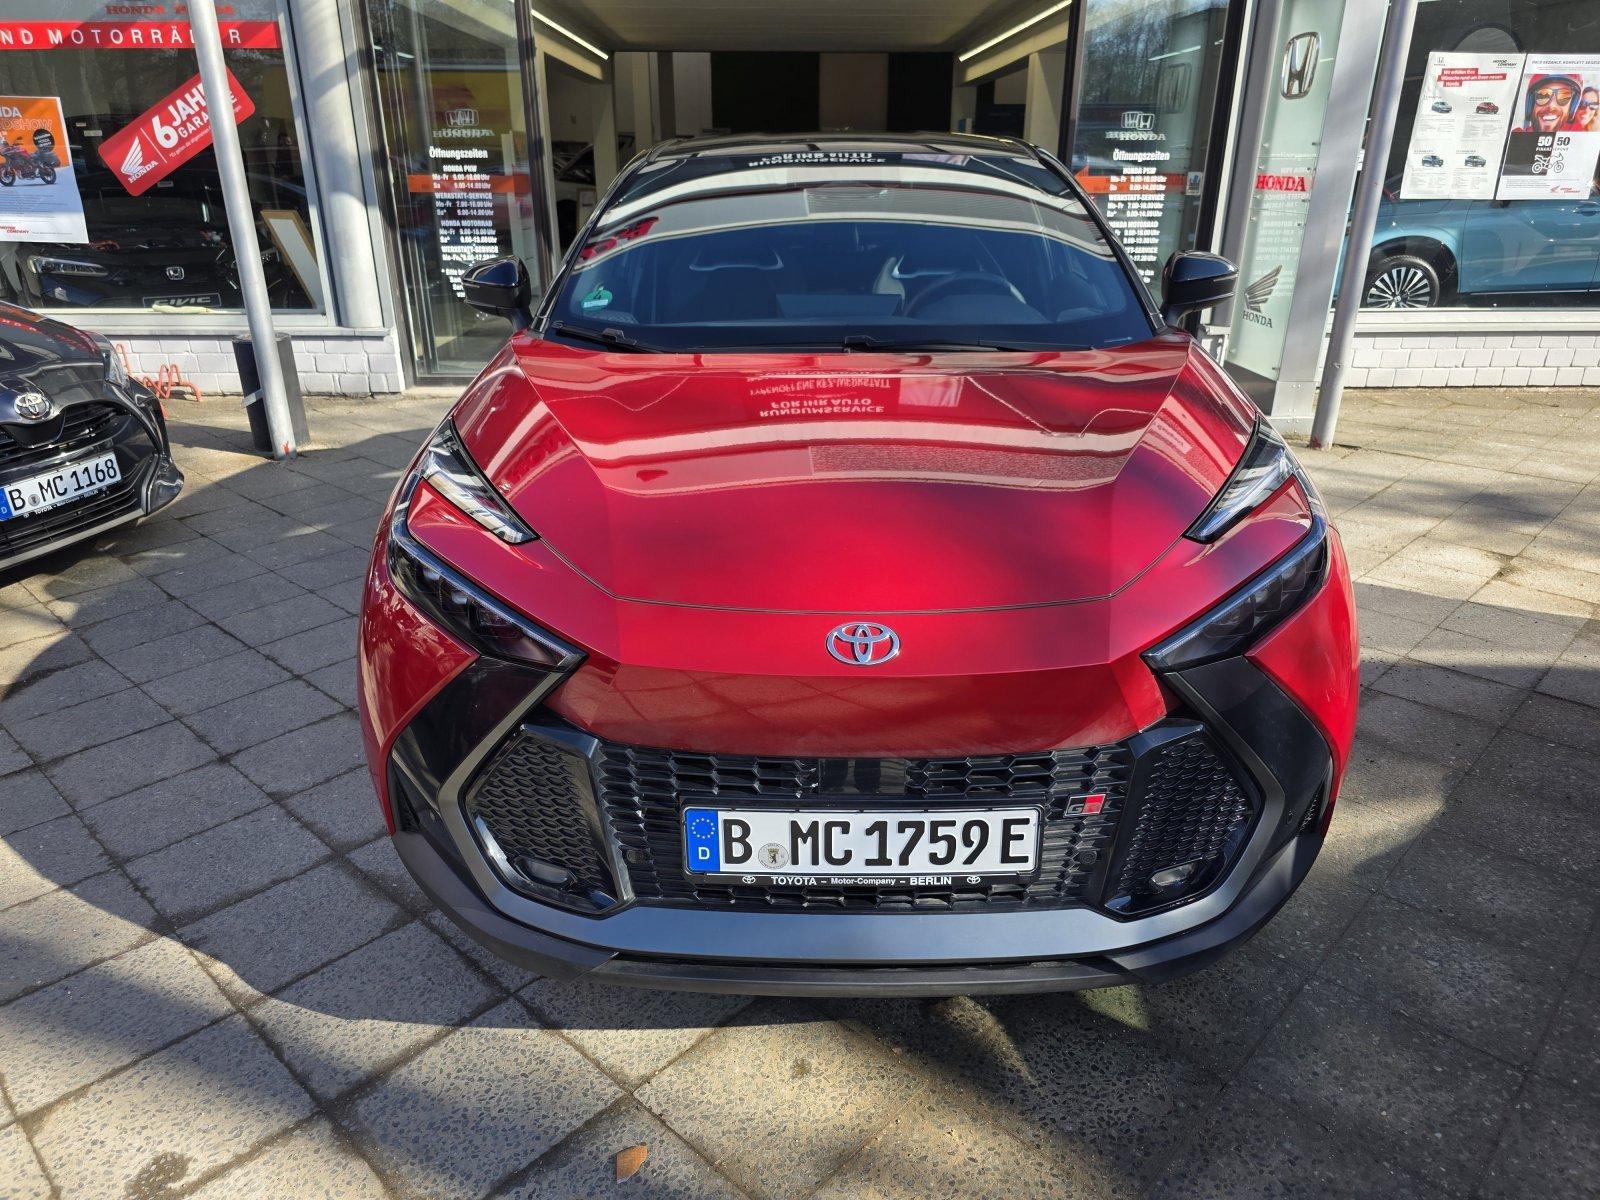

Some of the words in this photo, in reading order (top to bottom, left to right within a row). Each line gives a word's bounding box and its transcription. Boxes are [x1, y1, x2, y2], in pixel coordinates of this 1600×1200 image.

[48, 26, 241, 44] MOTORRÄR
[168, 82, 207, 127] JAH
[152, 114, 178, 148] 6
[1537, 136, 1552, 147] 50
[1557, 136, 1570, 147] 50
[429, 146, 488, 159] Öffnungszeiten
[1113, 148, 1170, 162] Öffnungszeiten
[128, 160, 159, 184] HONDA
[1255, 175, 1306, 192] HONDA
[154, 297, 211, 306] CIVIC
[1242, 310, 1273, 329] HONDA
[8, 488, 26, 511] B
[37, 475, 67, 502] MC
[70, 459, 117, 492] 1168
[723, 818, 753, 866] B
[790, 820, 853, 866] MC
[865, 819, 990, 867] 1759
[1001, 817, 1031, 864] E
[698, 847, 710, 860] D
[771, 876, 817, 886] TOYOTA
[830, 877, 896, 886] Motor-Company
[909, 876, 952, 886] BERLIN
